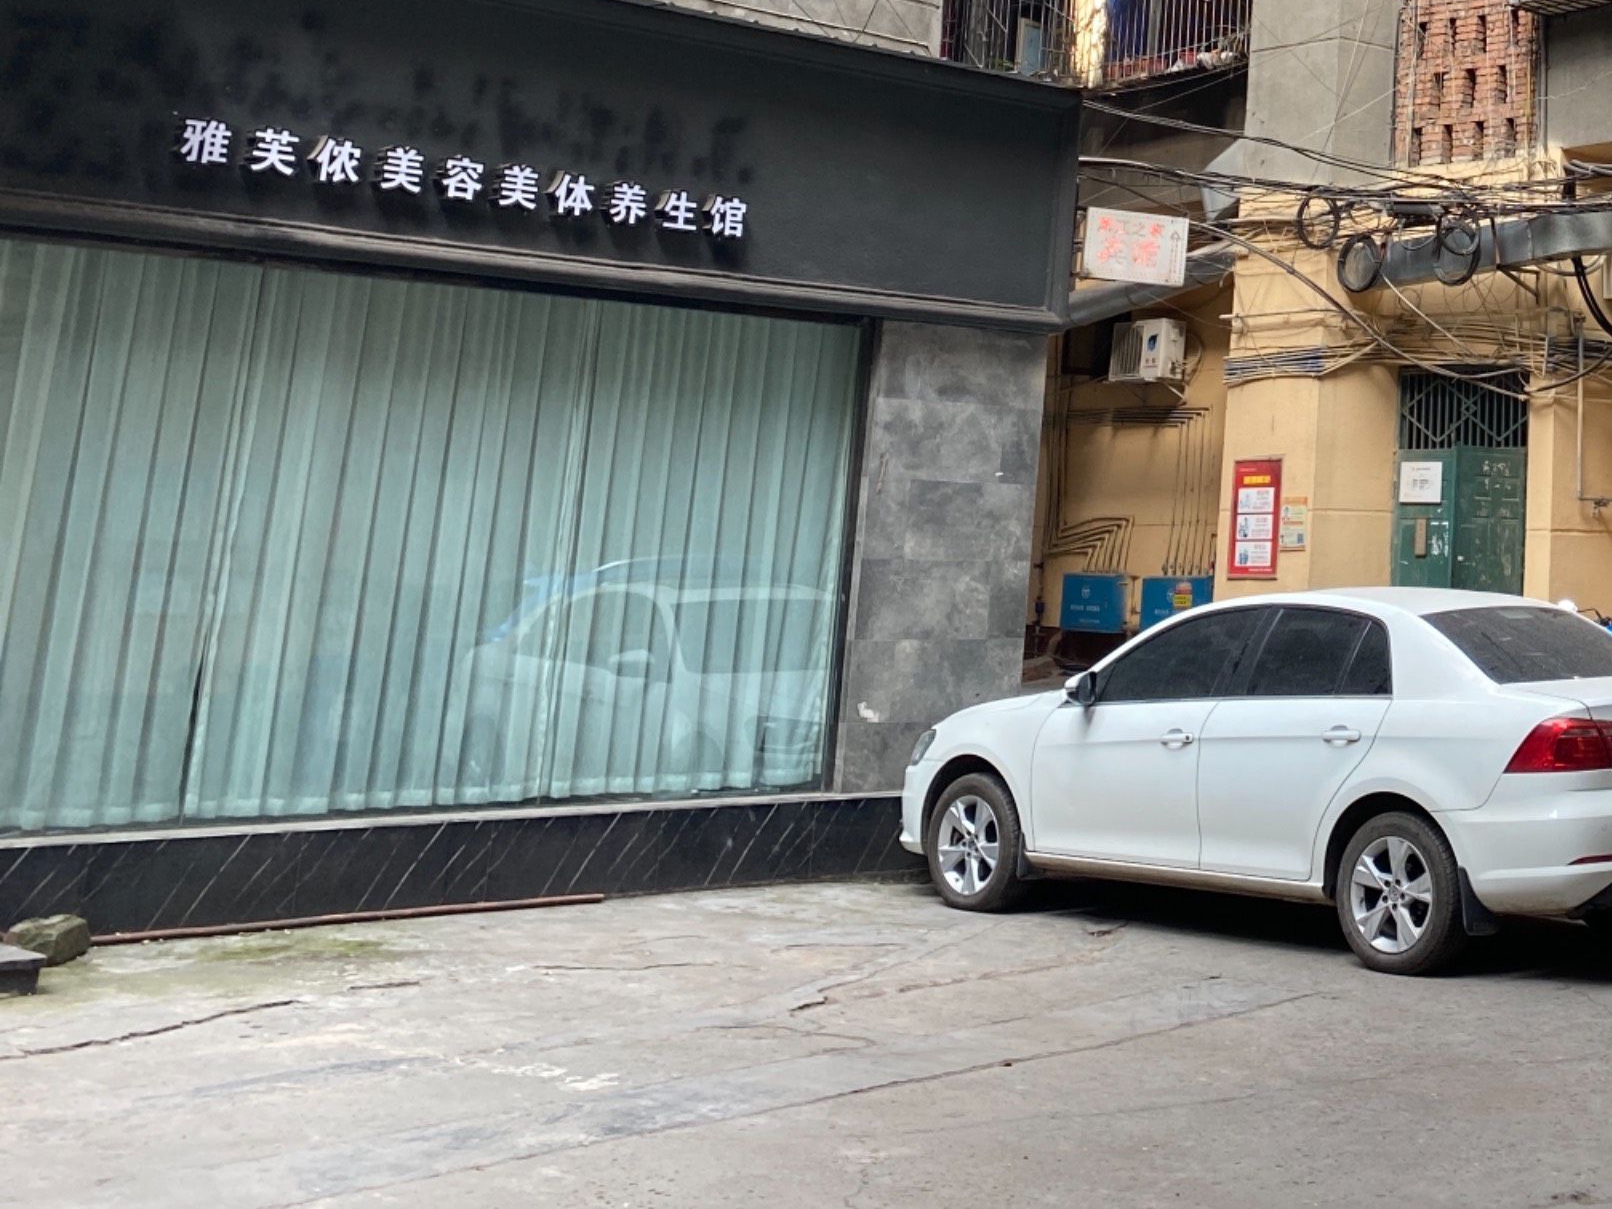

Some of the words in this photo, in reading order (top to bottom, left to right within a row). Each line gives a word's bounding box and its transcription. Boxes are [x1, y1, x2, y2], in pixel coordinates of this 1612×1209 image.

[180, 118, 748, 238] 雅芙侬美容美体养生馆
